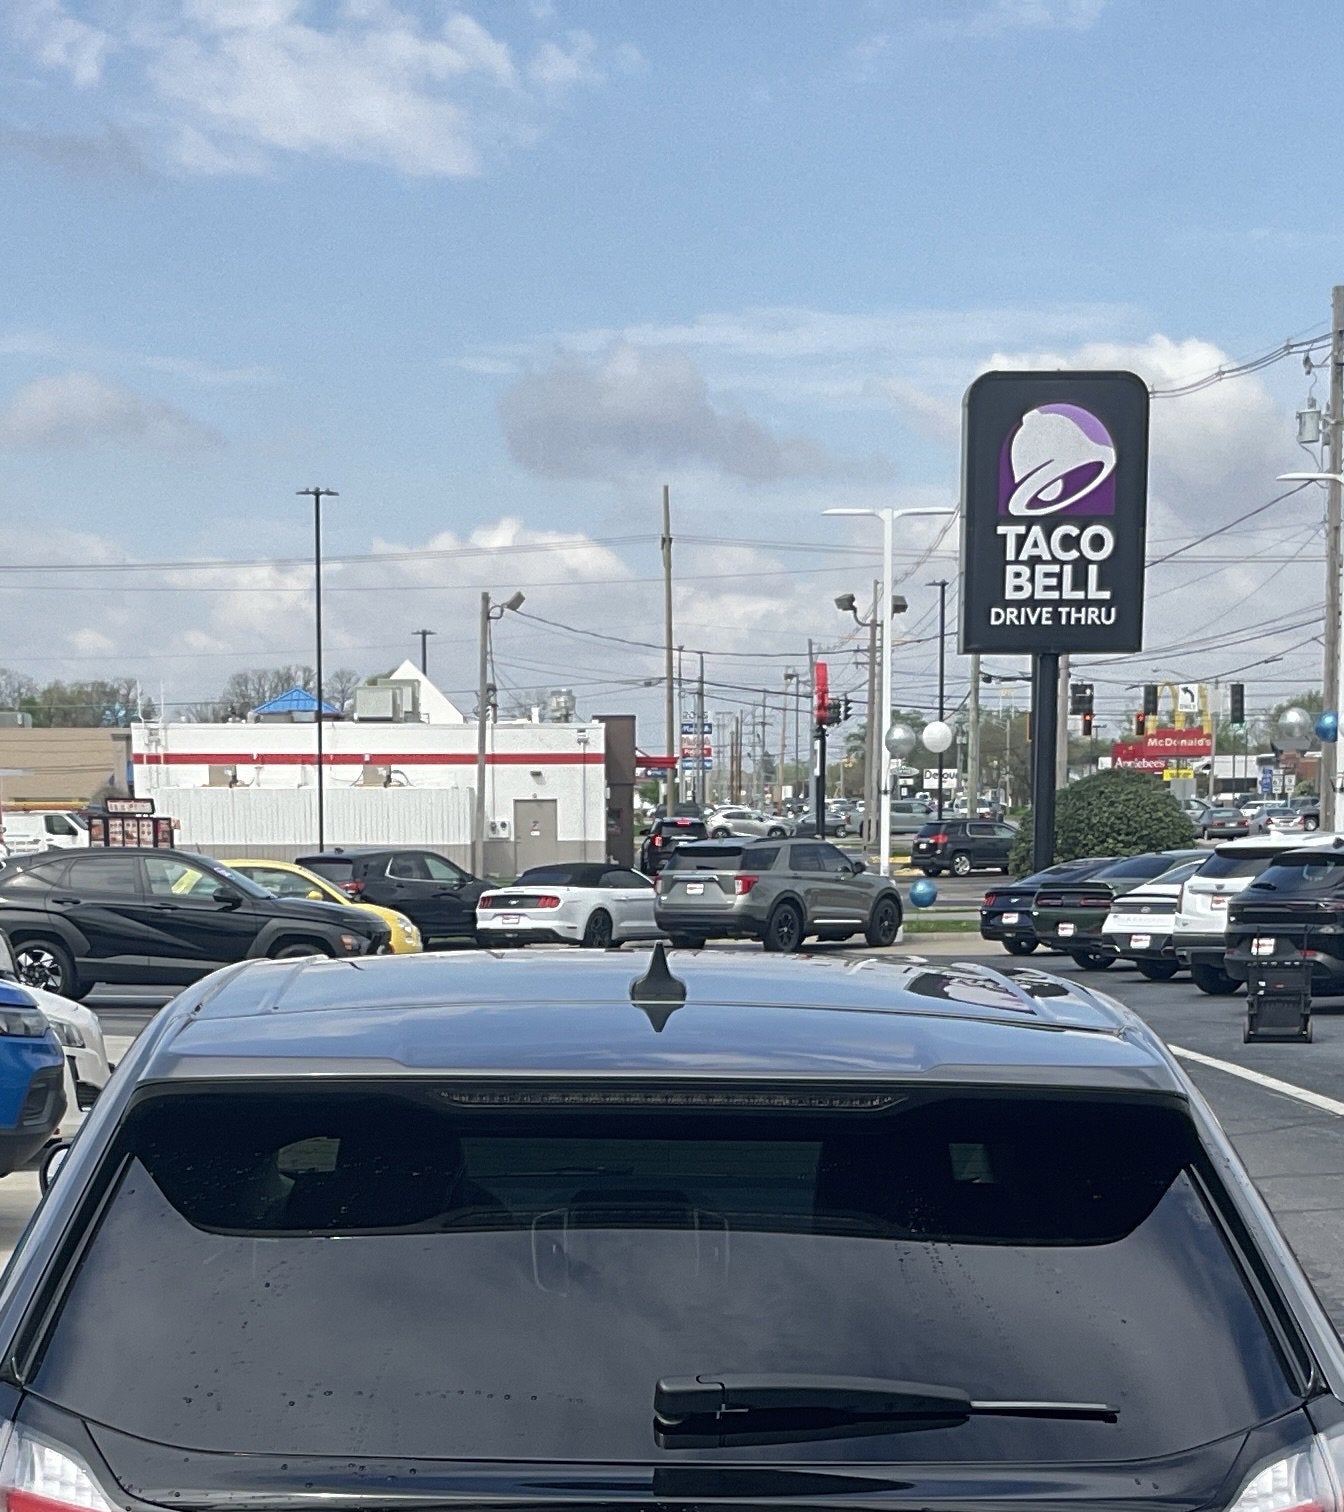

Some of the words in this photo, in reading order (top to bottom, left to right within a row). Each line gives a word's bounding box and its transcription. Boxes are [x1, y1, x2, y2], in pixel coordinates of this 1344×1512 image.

[996, 524, 1115, 562] TACO
[1003, 564, 1112, 601] BELL
[990, 606, 1053, 625] DRIVE
[1058, 606, 1116, 626] THRU
[924, 769, 958, 780] Deou
